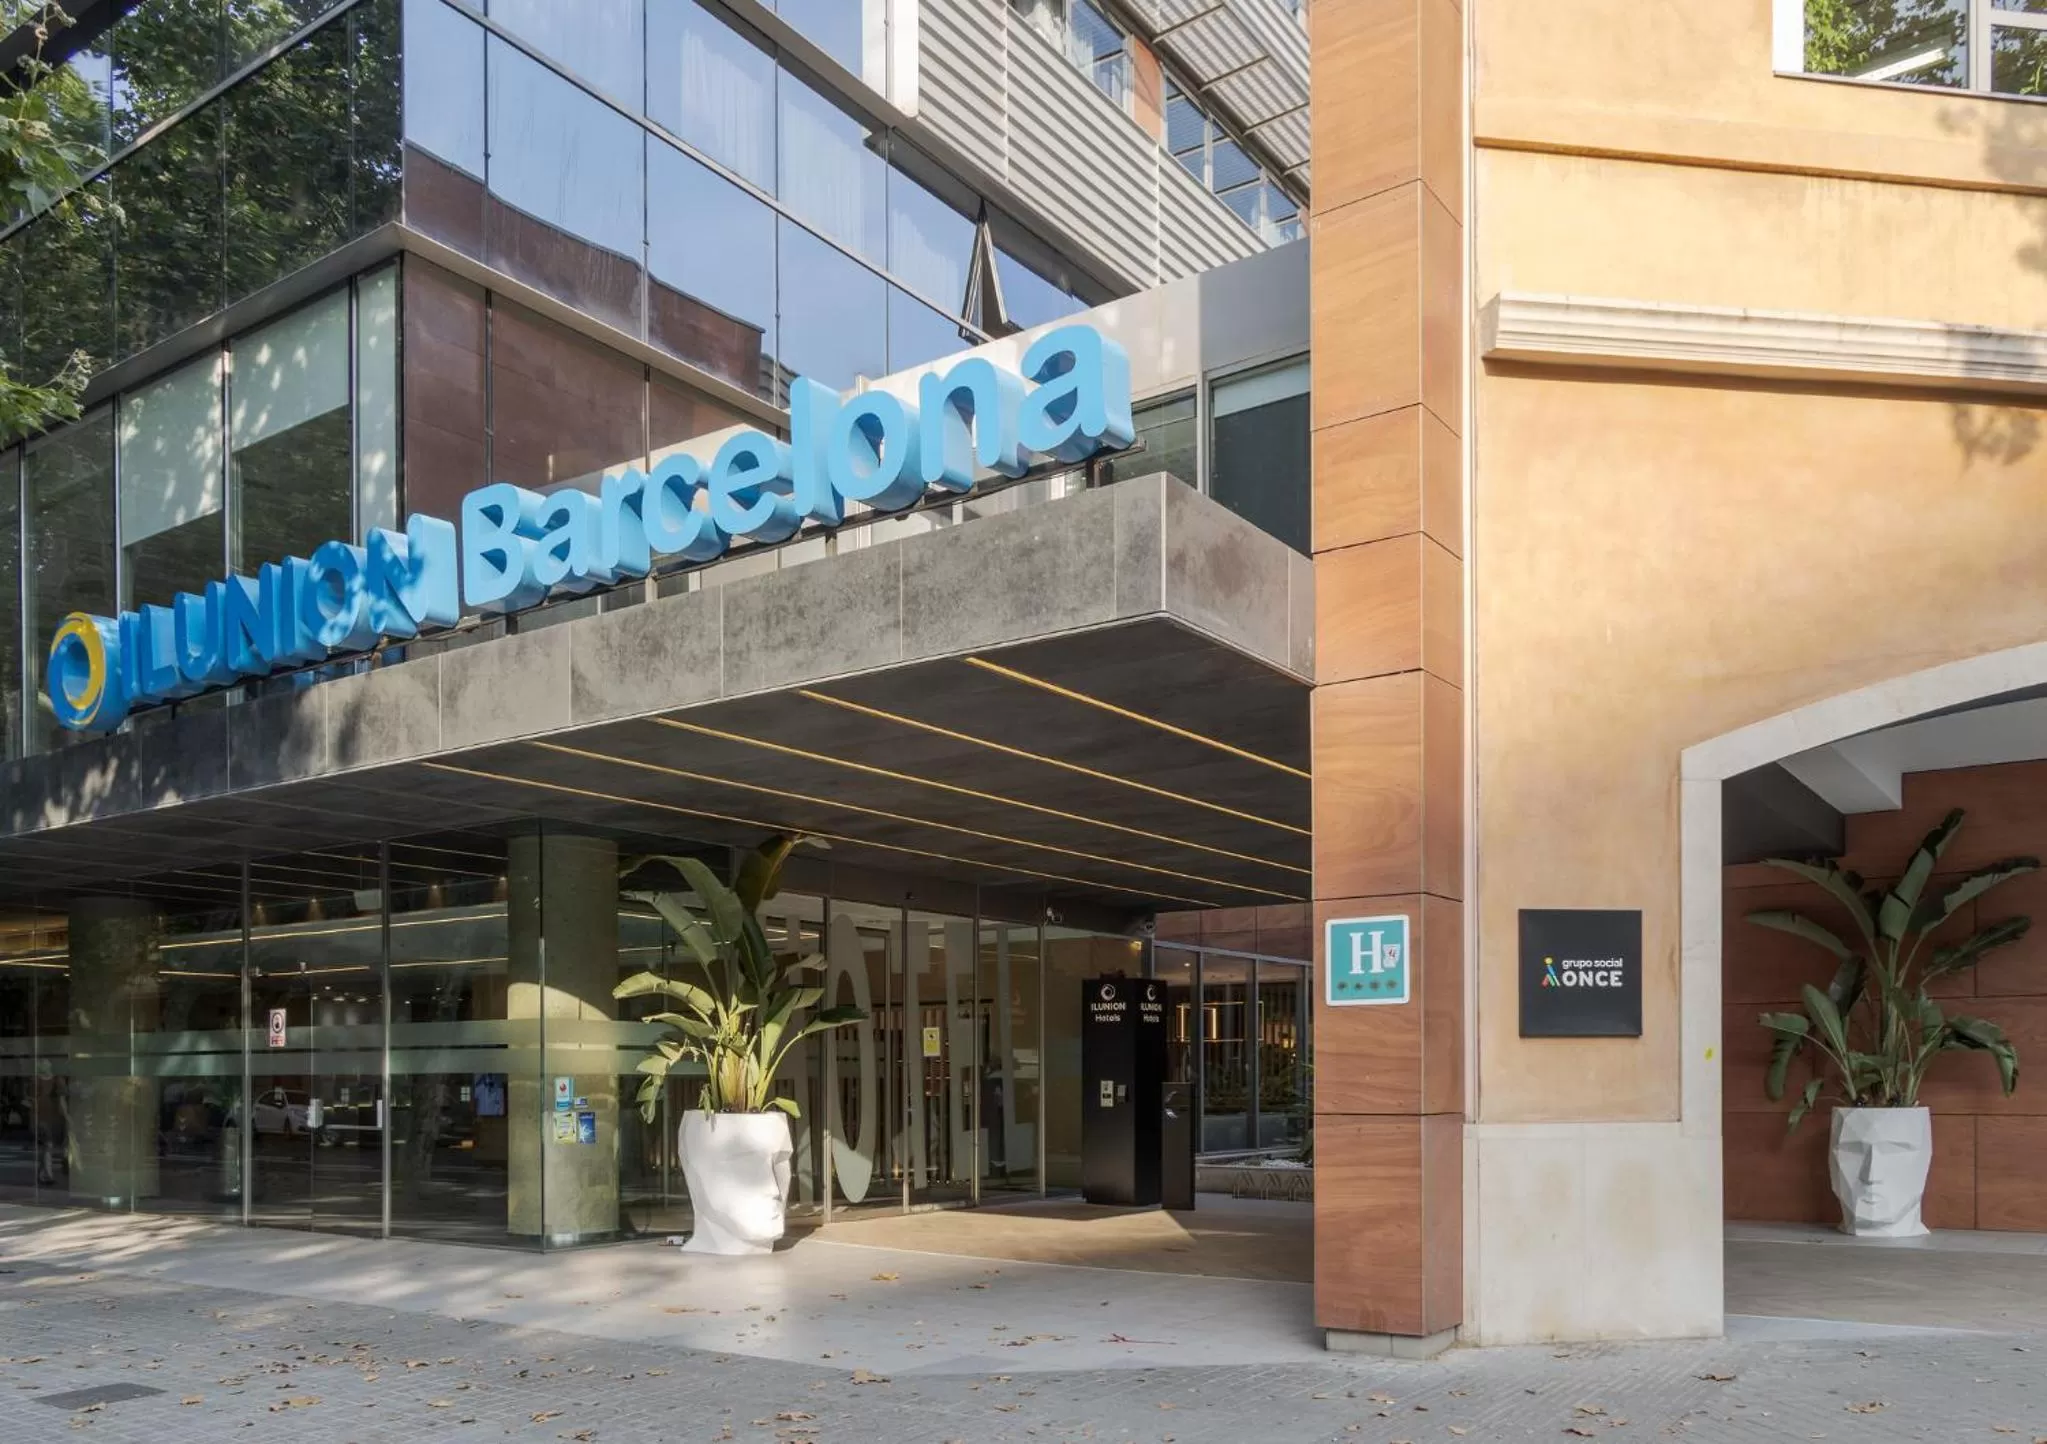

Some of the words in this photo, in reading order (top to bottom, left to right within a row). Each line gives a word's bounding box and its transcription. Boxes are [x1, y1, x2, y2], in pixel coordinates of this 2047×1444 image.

[119, 513, 459, 703] ILUNION
[463, 325, 1132, 612] Barcelona
[1348, 930, 1385, 974] H
[1562, 959, 1593, 970] grupo
[1593, 957, 1623, 968] social
[1562, 970, 1623, 987] ONCE
[1090, 1002, 1126, 1011] ILUNION
[1095, 1013, 1121, 1022] Hotels
